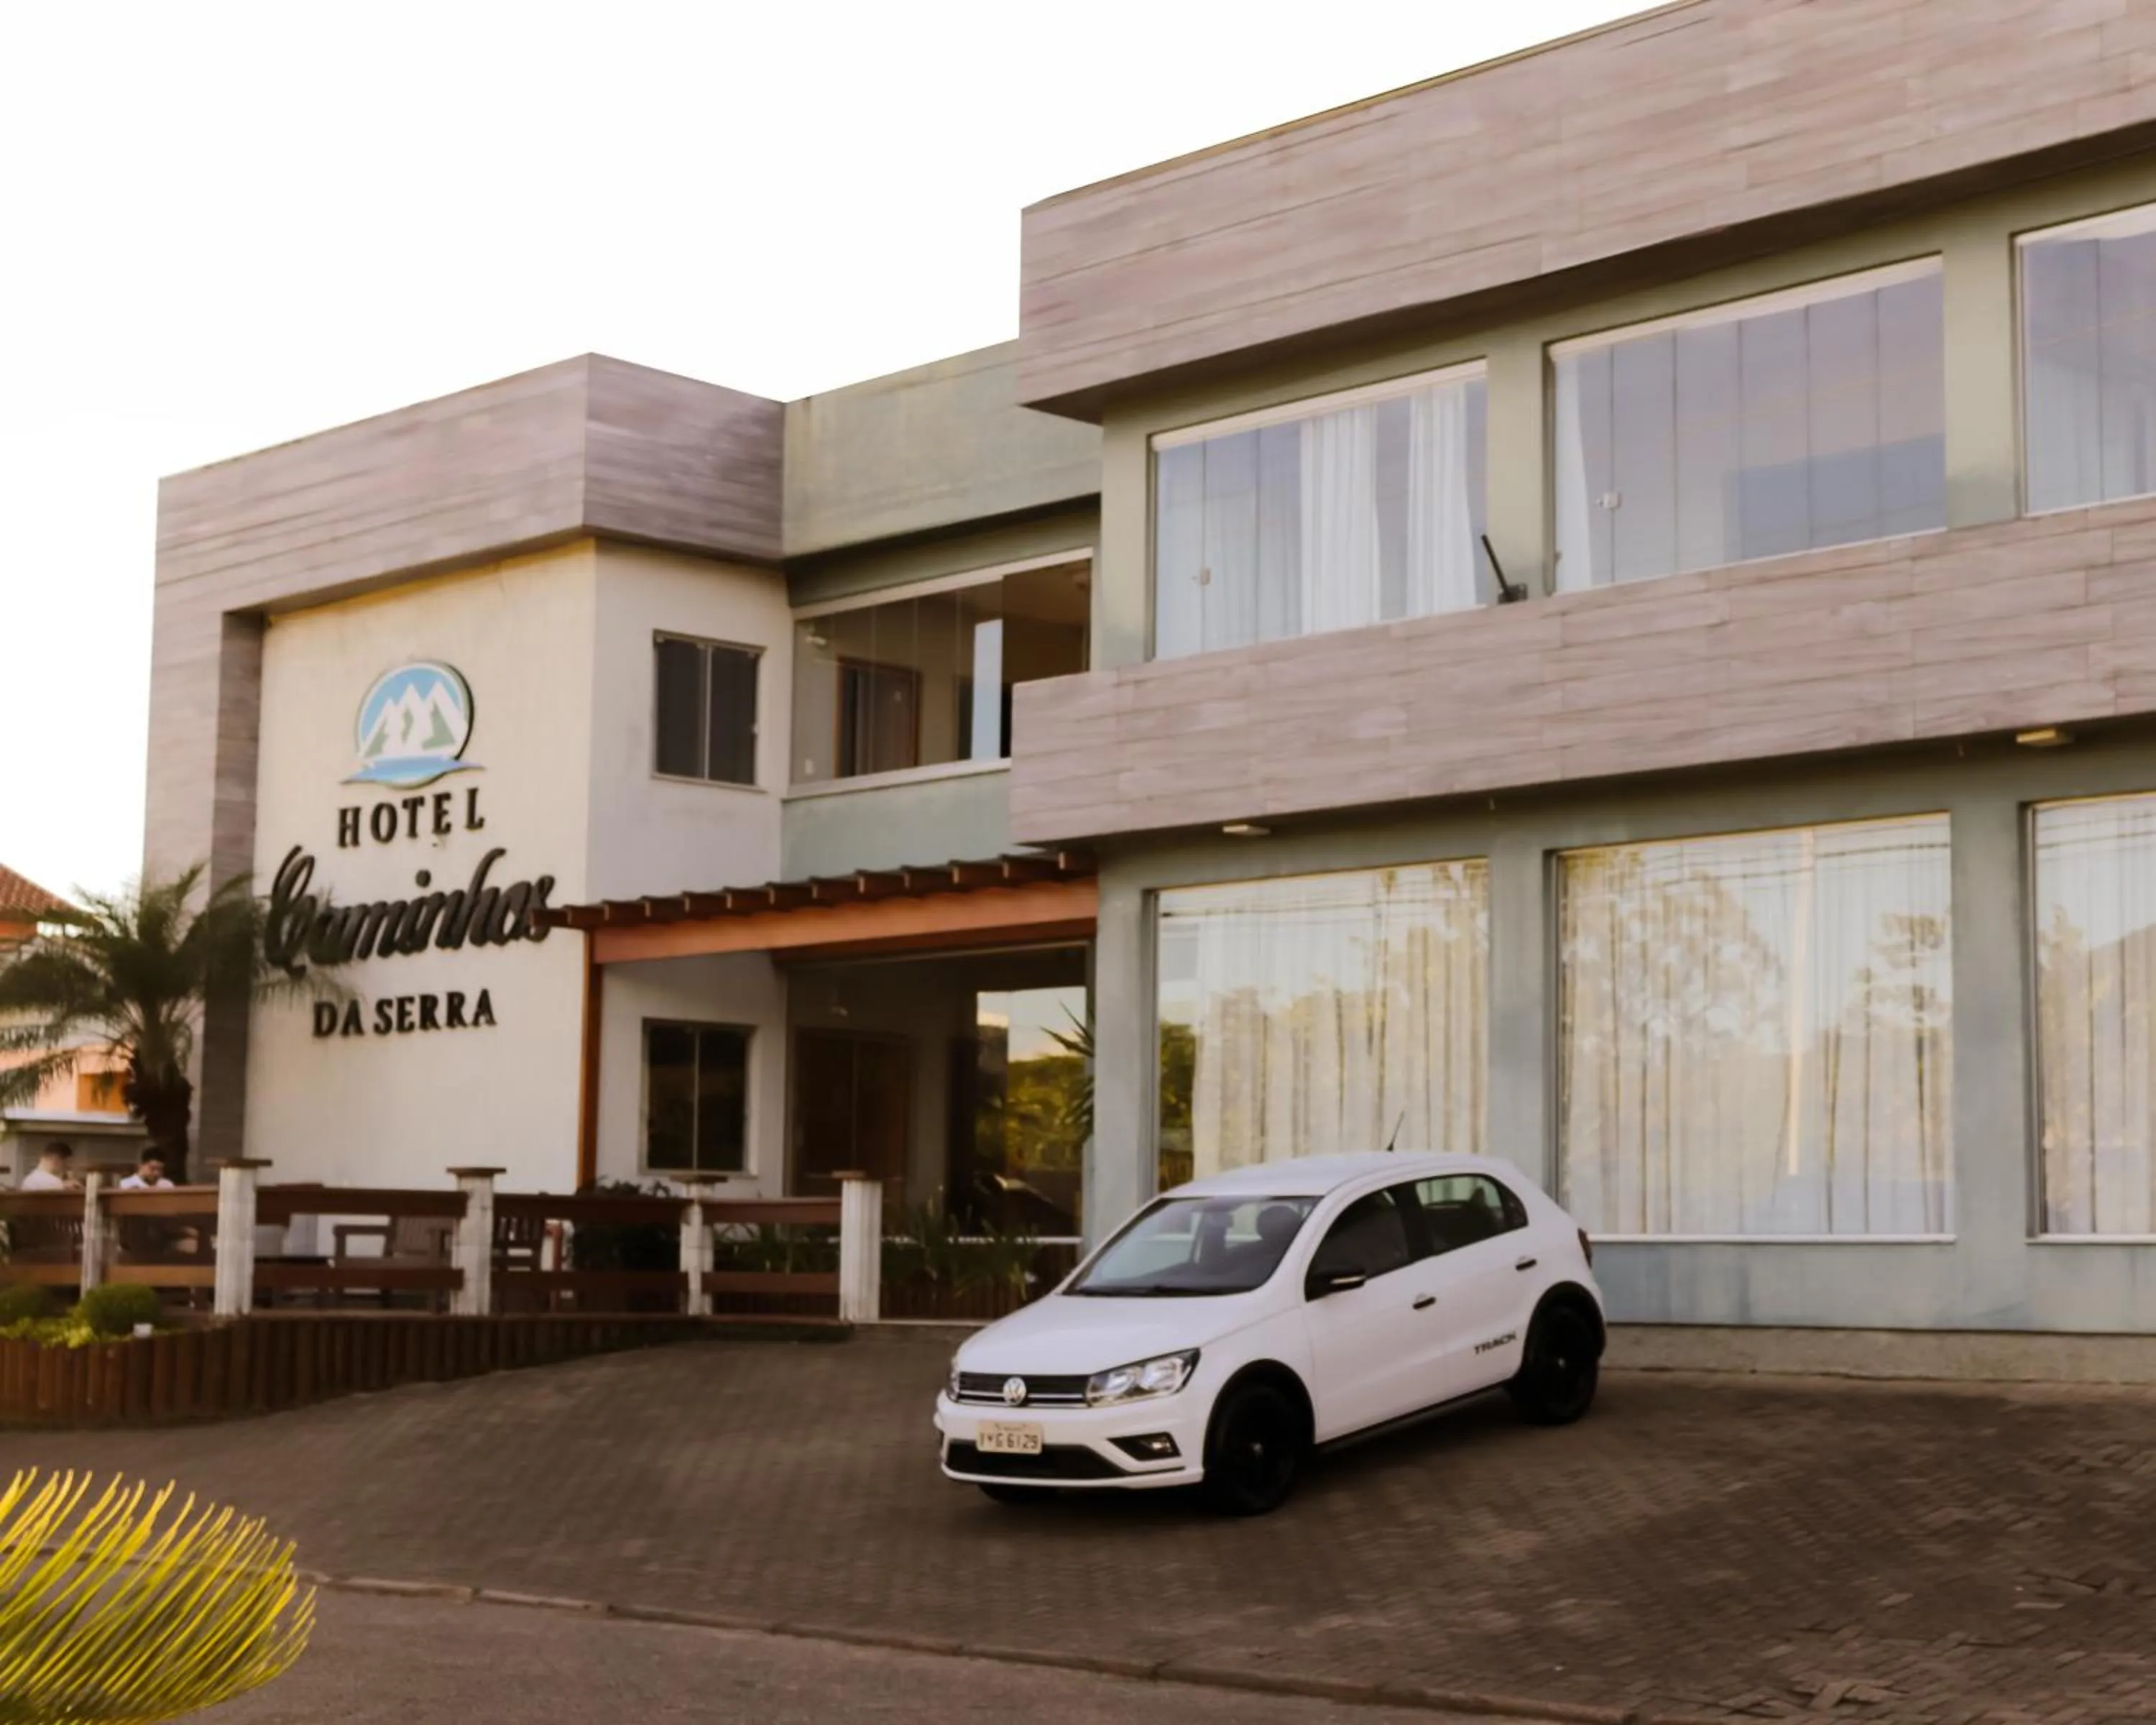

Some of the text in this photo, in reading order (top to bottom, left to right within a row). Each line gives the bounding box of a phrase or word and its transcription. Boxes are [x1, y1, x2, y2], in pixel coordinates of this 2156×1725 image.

[337, 787, 485, 848] HOTEL
[312, 988, 497, 1038] DA SERRA
